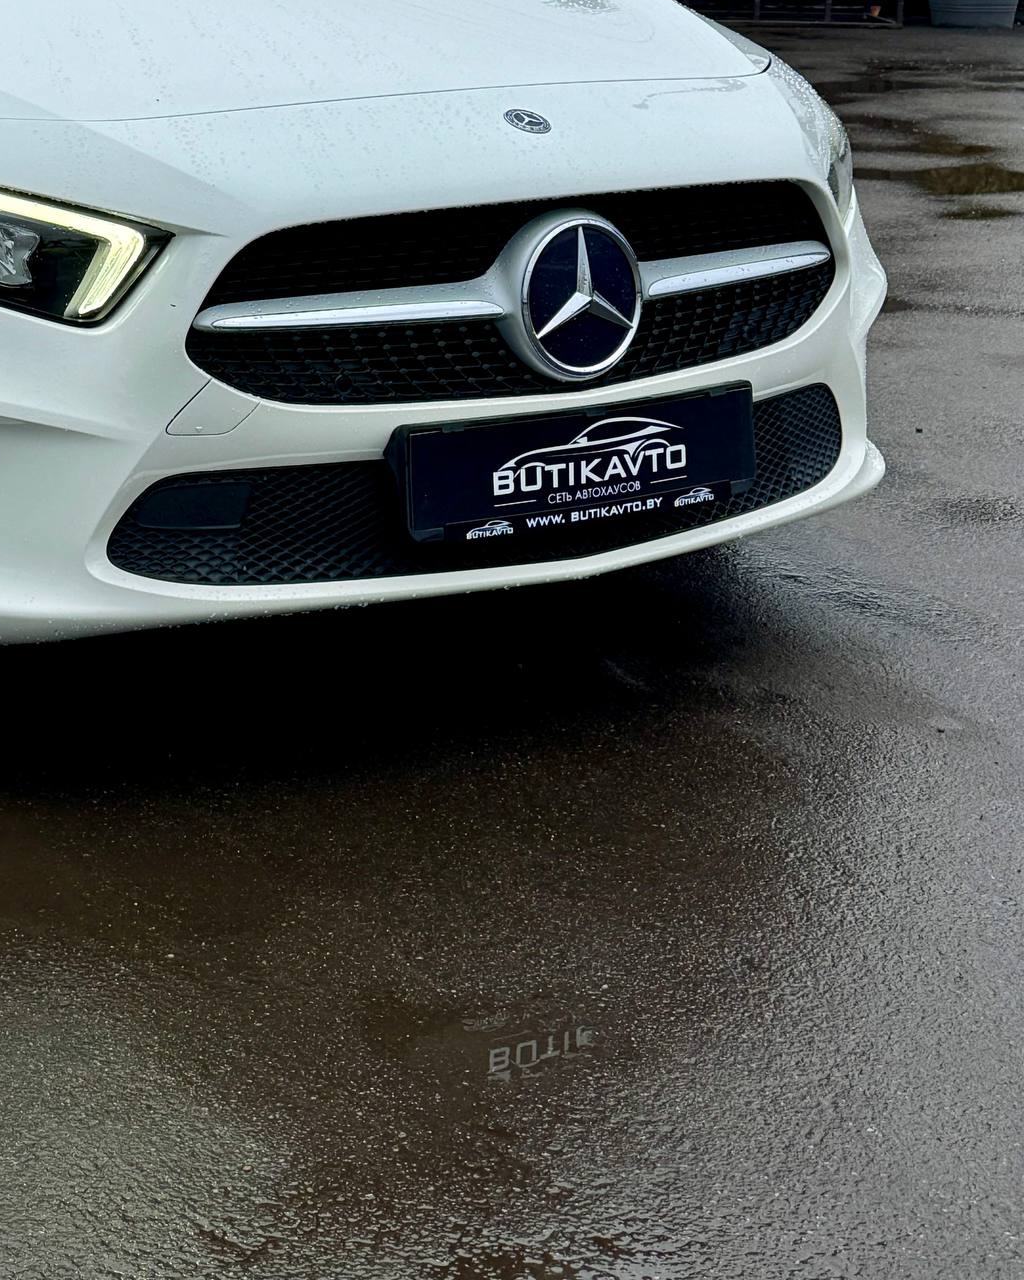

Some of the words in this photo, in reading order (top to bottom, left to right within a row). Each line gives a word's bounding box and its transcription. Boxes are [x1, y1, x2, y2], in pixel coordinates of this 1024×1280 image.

[493, 444, 687, 496] BUTIKAVTO
[548, 492, 573, 504] СЕТЬ
[575, 481, 641, 501] АВТОХАУСОВ
[674, 493, 715, 508] BUTIKAVTO
[526, 514, 566, 528] WWW.
[571, 497, 663, 522] BUTIKAVTO.BY
[466, 526, 514, 539] BUTIKAVTO
